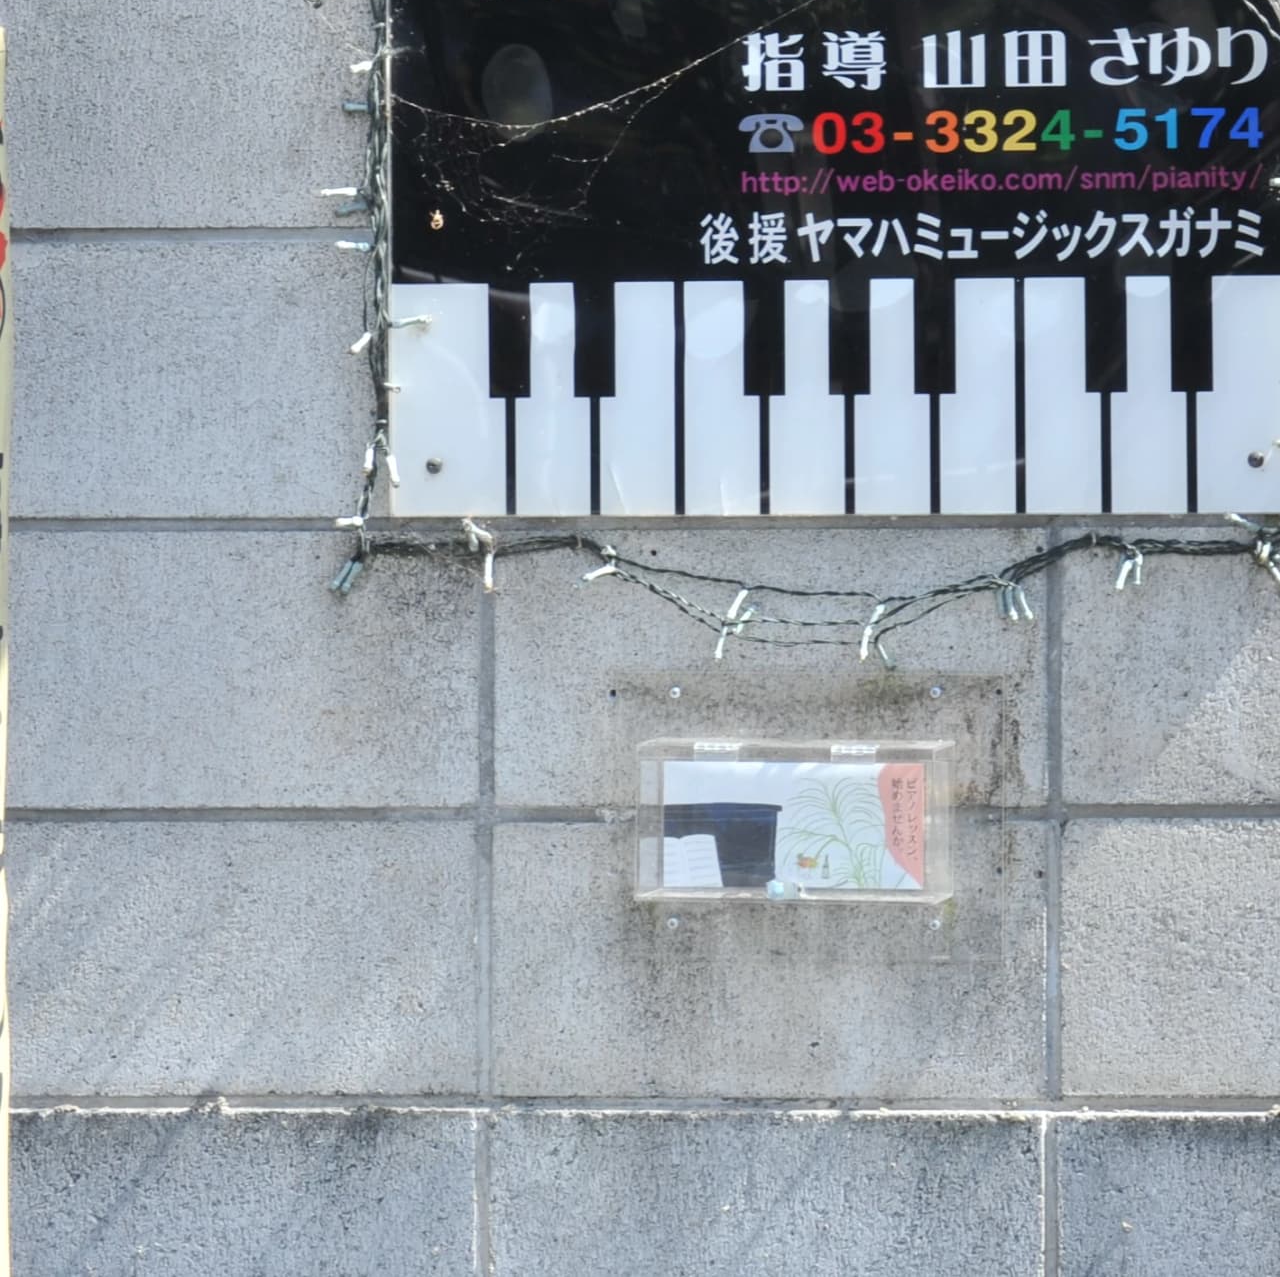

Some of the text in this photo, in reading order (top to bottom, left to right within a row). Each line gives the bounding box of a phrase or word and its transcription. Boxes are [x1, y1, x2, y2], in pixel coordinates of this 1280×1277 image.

[741, 26, 1269, 92] 指導 山田 さゆり
[811, 106, 1264, 155] 03-3324-5174
[740, 164, 1263, 198] http://web-okeiko.com/snm/pianity/
